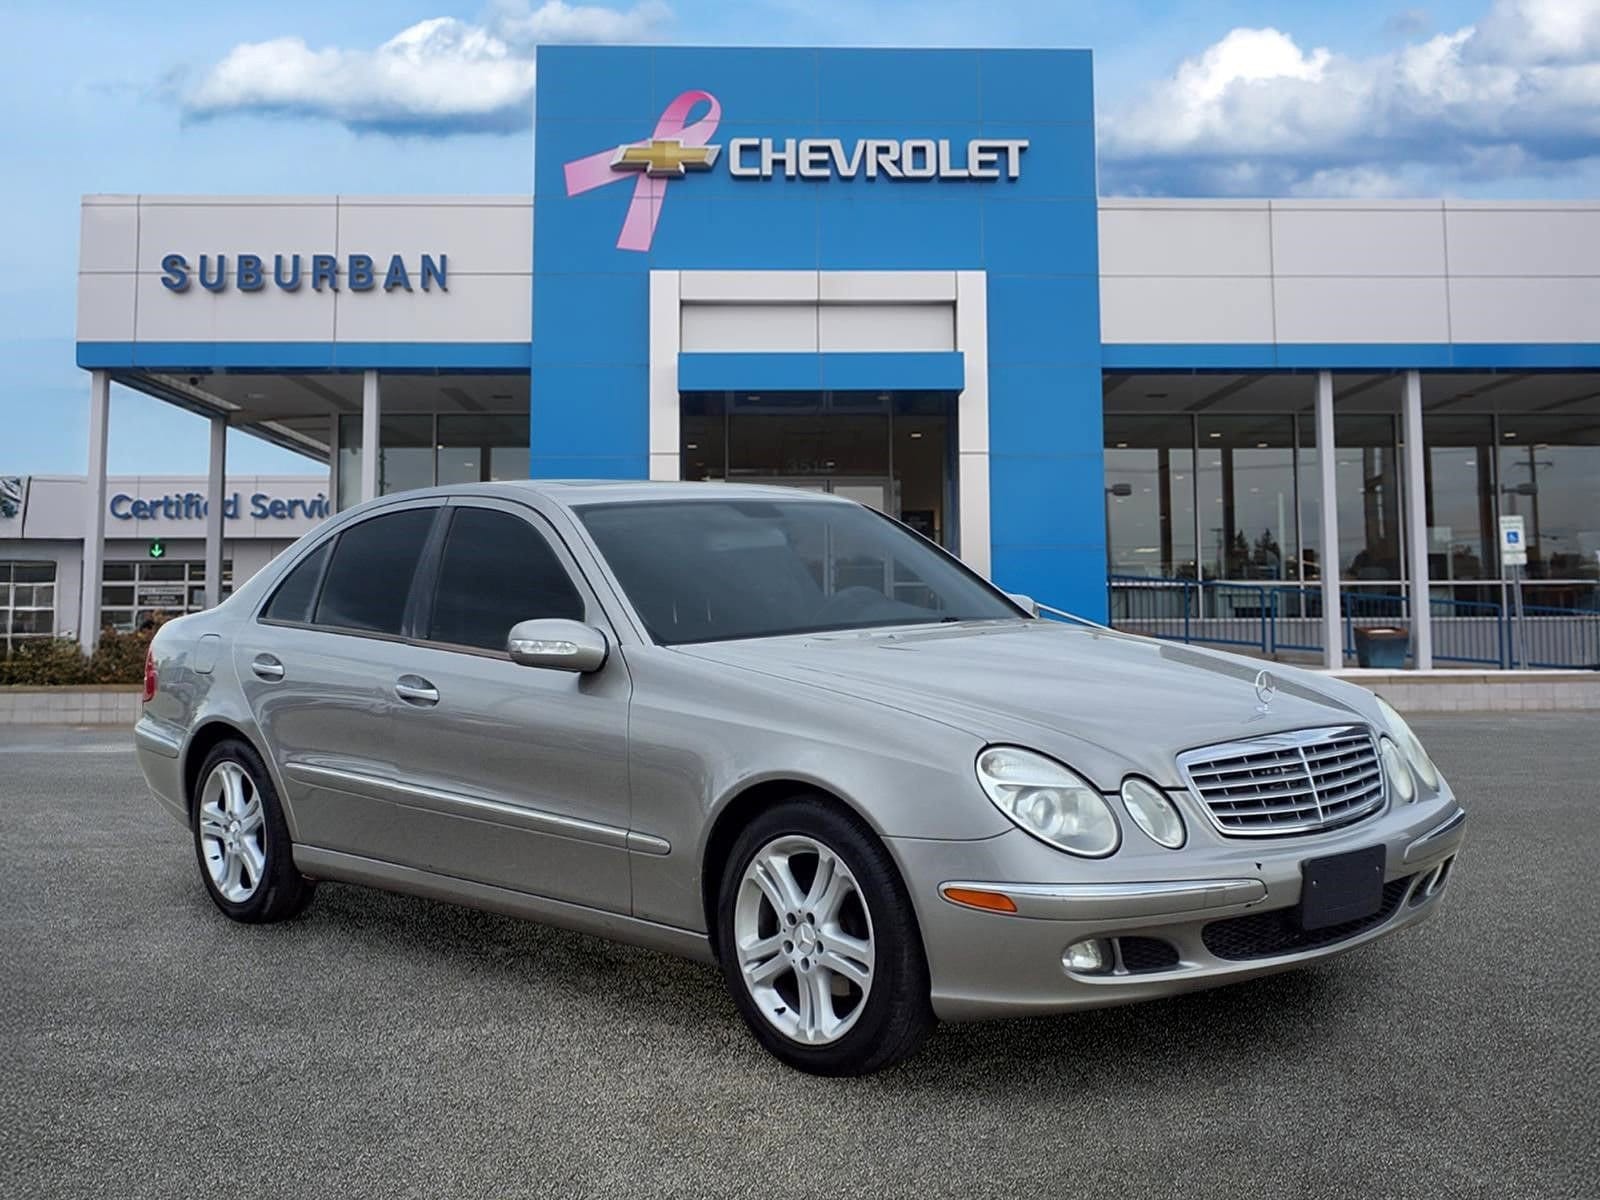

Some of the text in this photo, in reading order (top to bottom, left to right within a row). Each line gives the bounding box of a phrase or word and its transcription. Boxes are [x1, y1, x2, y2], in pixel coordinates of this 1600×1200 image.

[728, 137, 1030, 179] CHEVROLET
[160, 253, 449, 293] SUBURBAN
[110, 492, 330, 521] Certifid Servi
